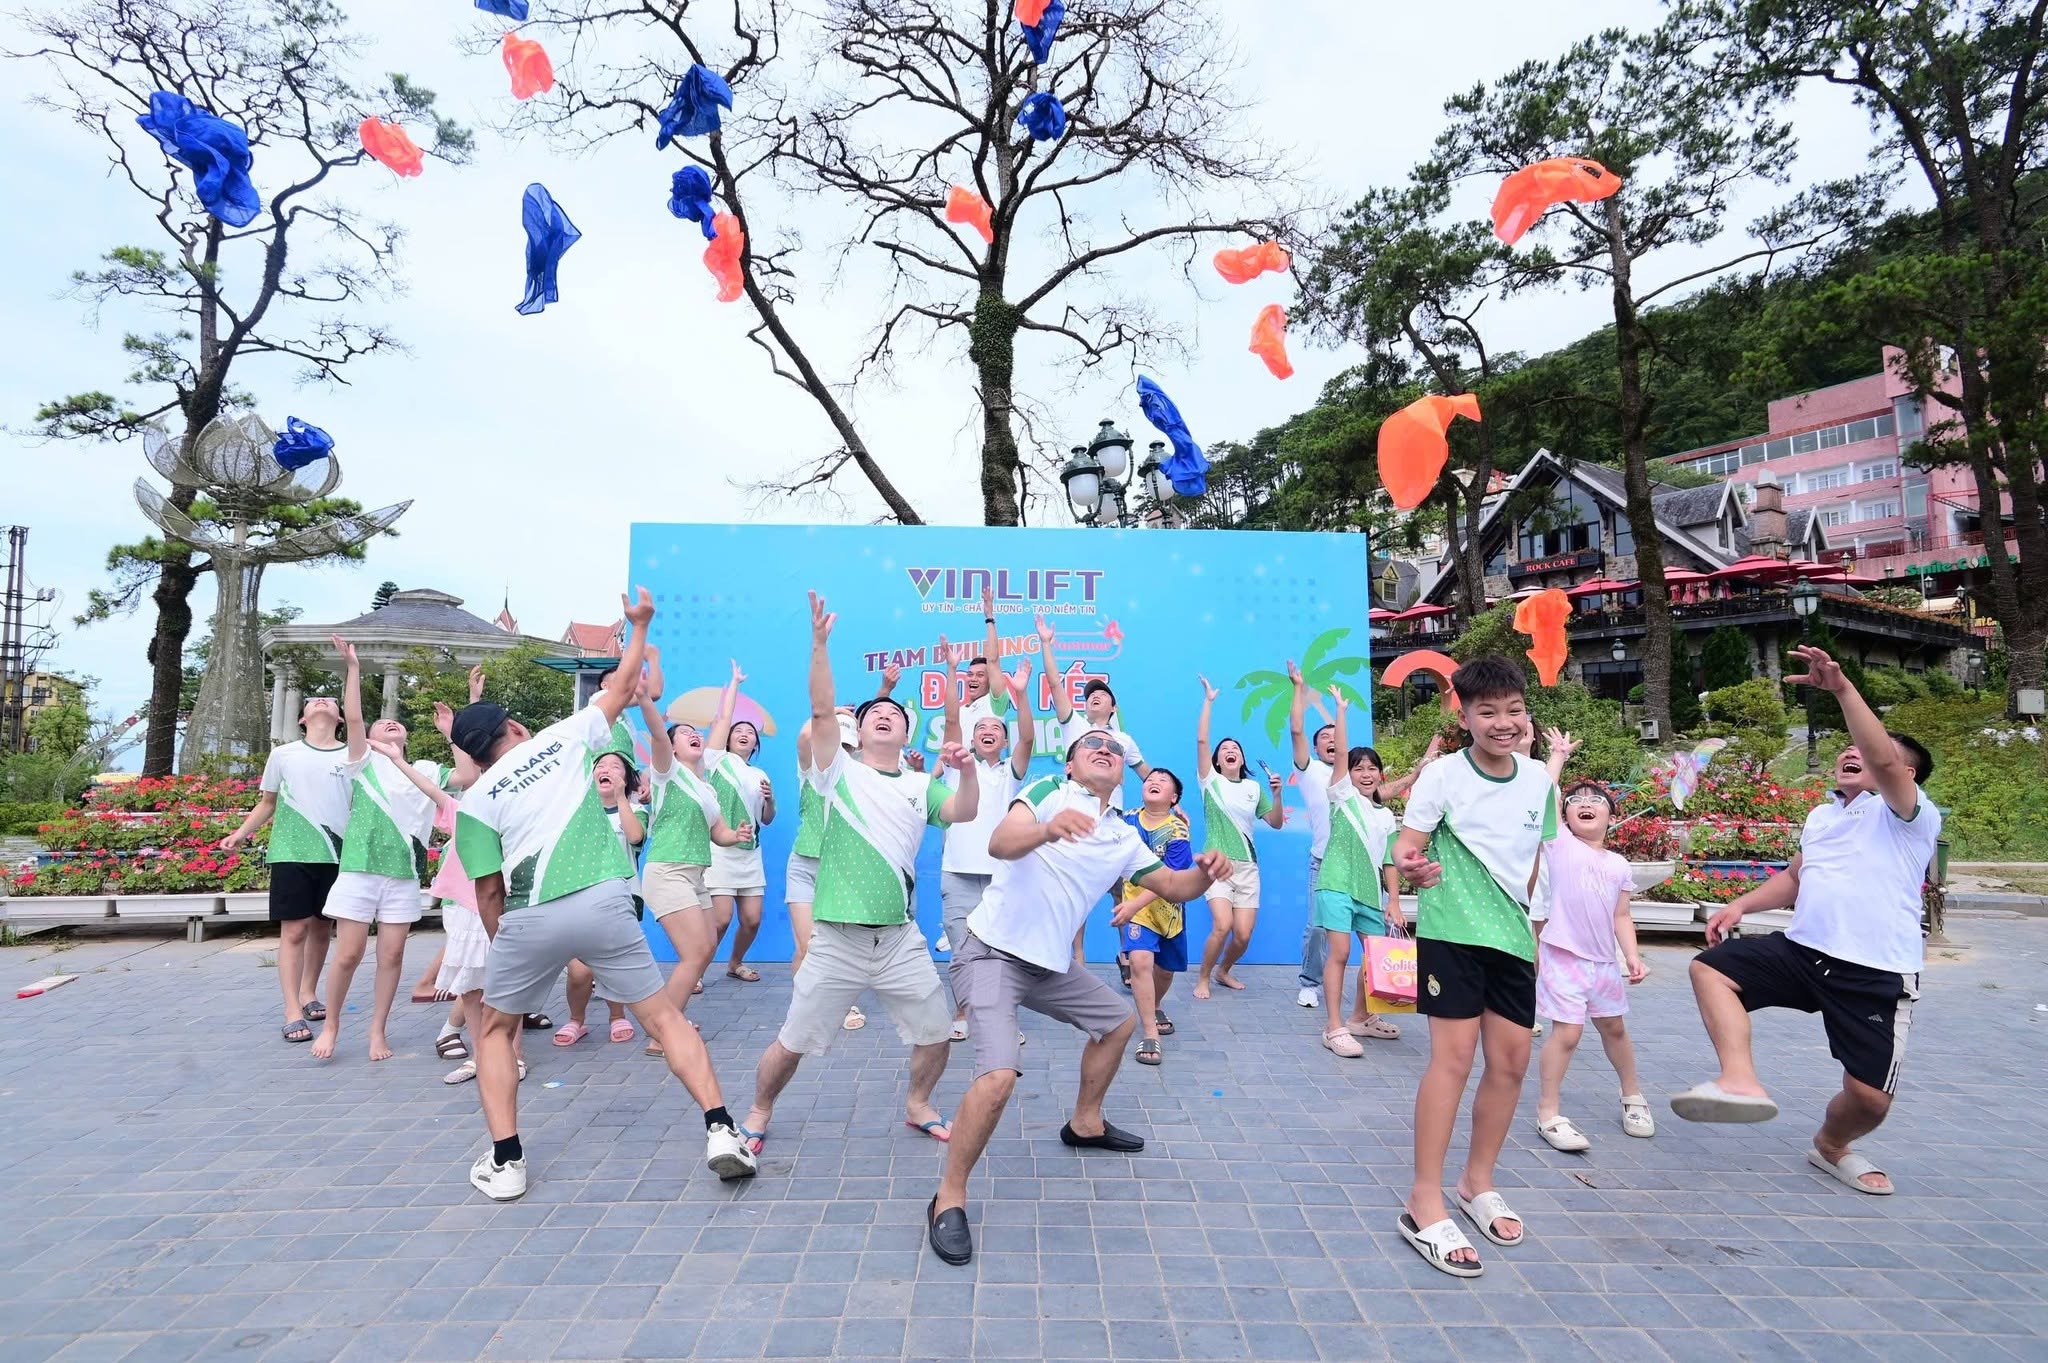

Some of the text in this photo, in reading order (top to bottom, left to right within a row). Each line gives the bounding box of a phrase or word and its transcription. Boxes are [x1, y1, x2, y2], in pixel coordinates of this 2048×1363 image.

[1526, 562, 1551, 572] ROCK
[1907, 560, 1952, 577] Smile
[906, 568, 1104, 601] VINLIFT
[922, 603, 935, 612] UY
[1080, 605, 1096, 614] TIN
[864, 647, 926, 673] TEAM
[508, 758, 561, 793] VINLIFT
[487, 776, 513, 800] XE
